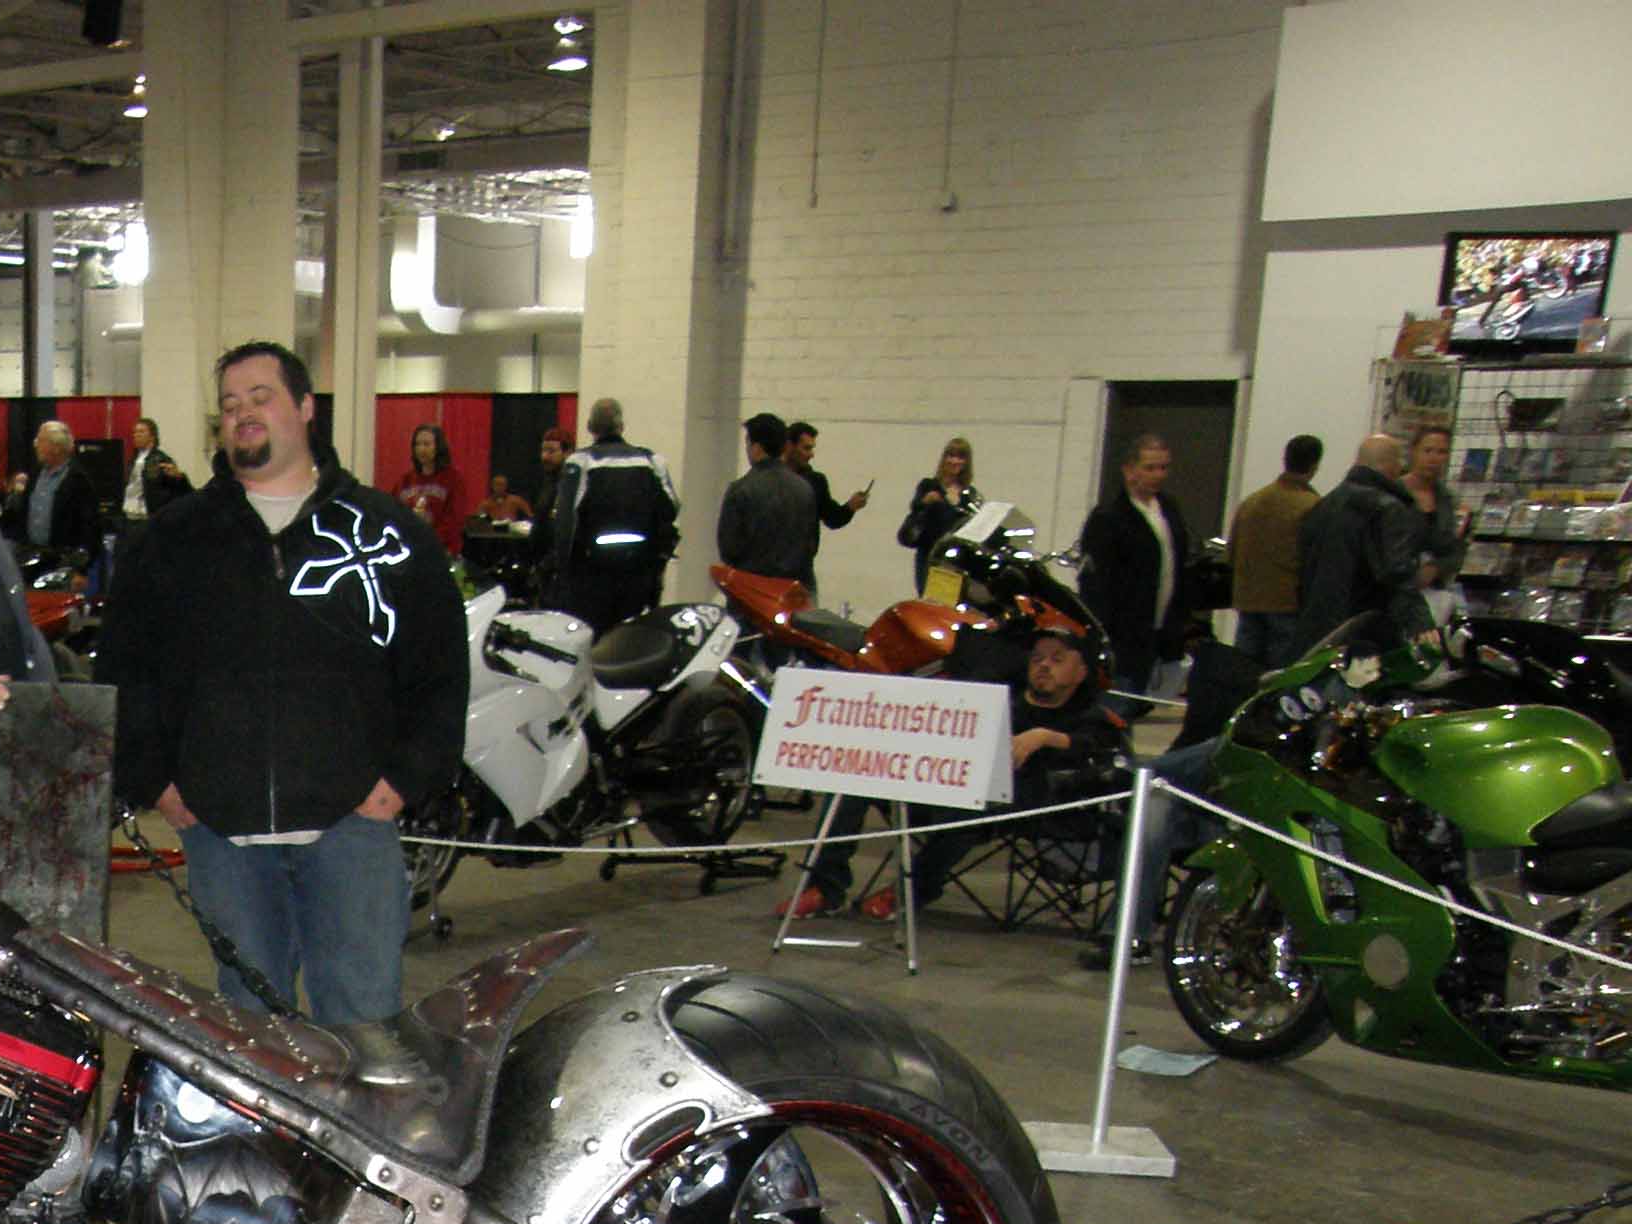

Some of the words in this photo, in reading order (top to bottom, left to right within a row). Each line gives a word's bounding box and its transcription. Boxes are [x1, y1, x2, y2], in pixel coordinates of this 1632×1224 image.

[784, 685, 979, 738] Frankenstein
[775, 741, 912, 781] PERFORMANCE
[915, 755, 970, 788] CYCLE
